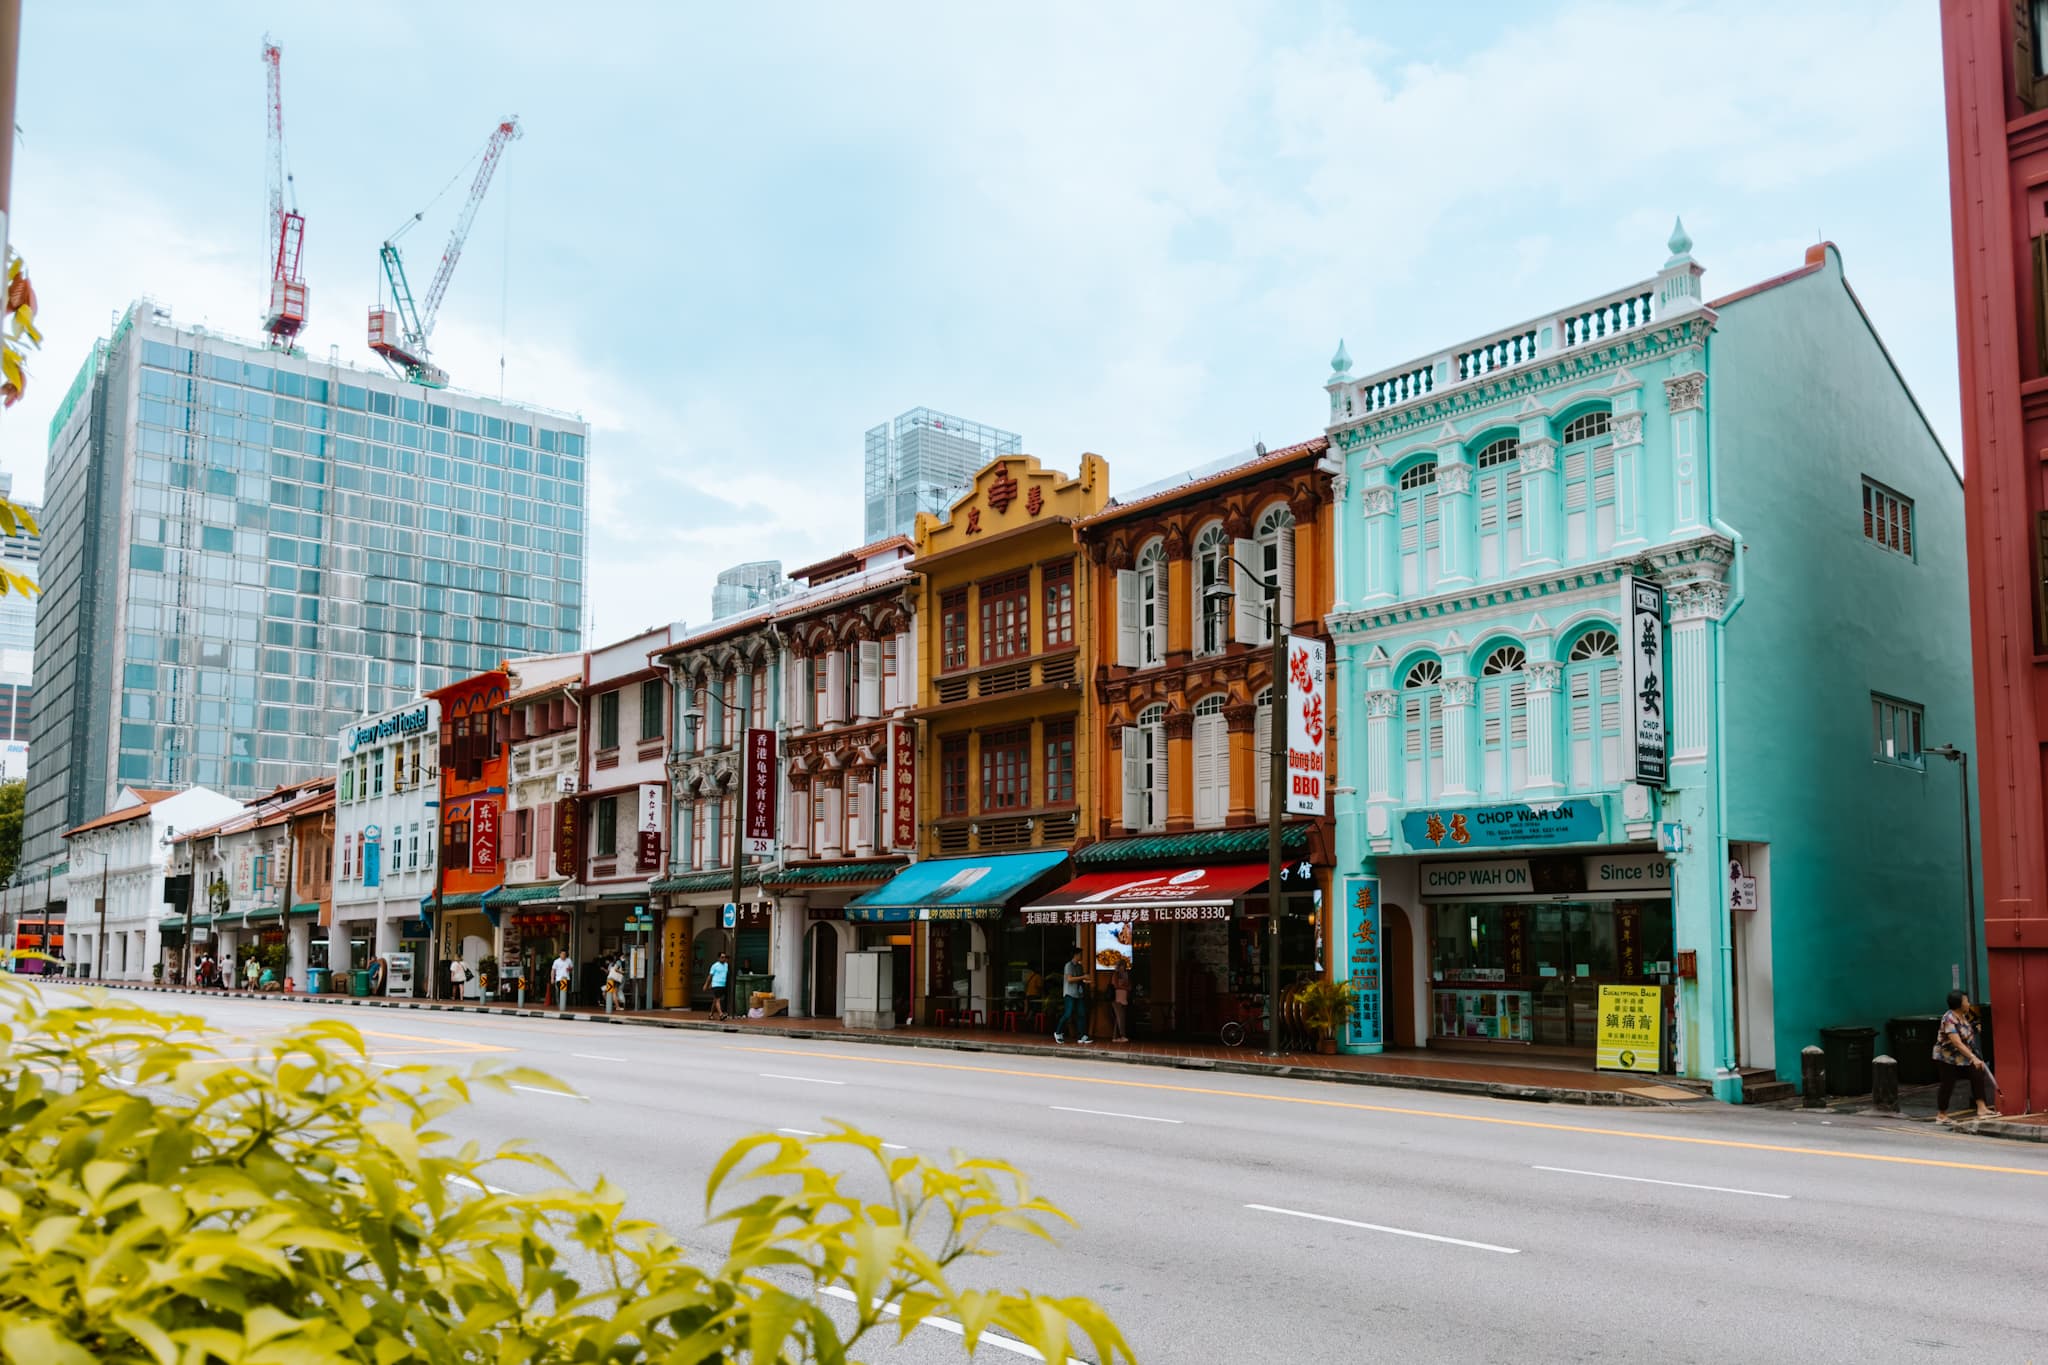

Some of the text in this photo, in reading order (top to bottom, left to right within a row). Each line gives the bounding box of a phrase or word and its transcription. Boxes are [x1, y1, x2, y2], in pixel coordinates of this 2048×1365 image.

[1640, 618, 1661, 716] 華安
[401, 705, 428, 731] hostel
[1643, 720, 1659, 730] CHOP
[1639, 731, 1663, 742] WAH ON
[1289, 748, 1323, 772] Dong Bei
[1293, 774, 1319, 799] BBQ
[1477, 811, 1513, 825] CHOP
[1552, 806, 1573, 820] ON
[476, 803, 493, 864] 东北人家
[754, 840, 767, 851] 28
[1429, 868, 1526, 886] CHOP WAH ON
[1601, 864, 1642, 881] Since
[1730, 863, 1742, 906] 華安
[939, 908, 956, 919] CROSS
[1154, 906, 1225, 920] TEL: 8588 3330
[1353, 887, 1377, 944] 華安
